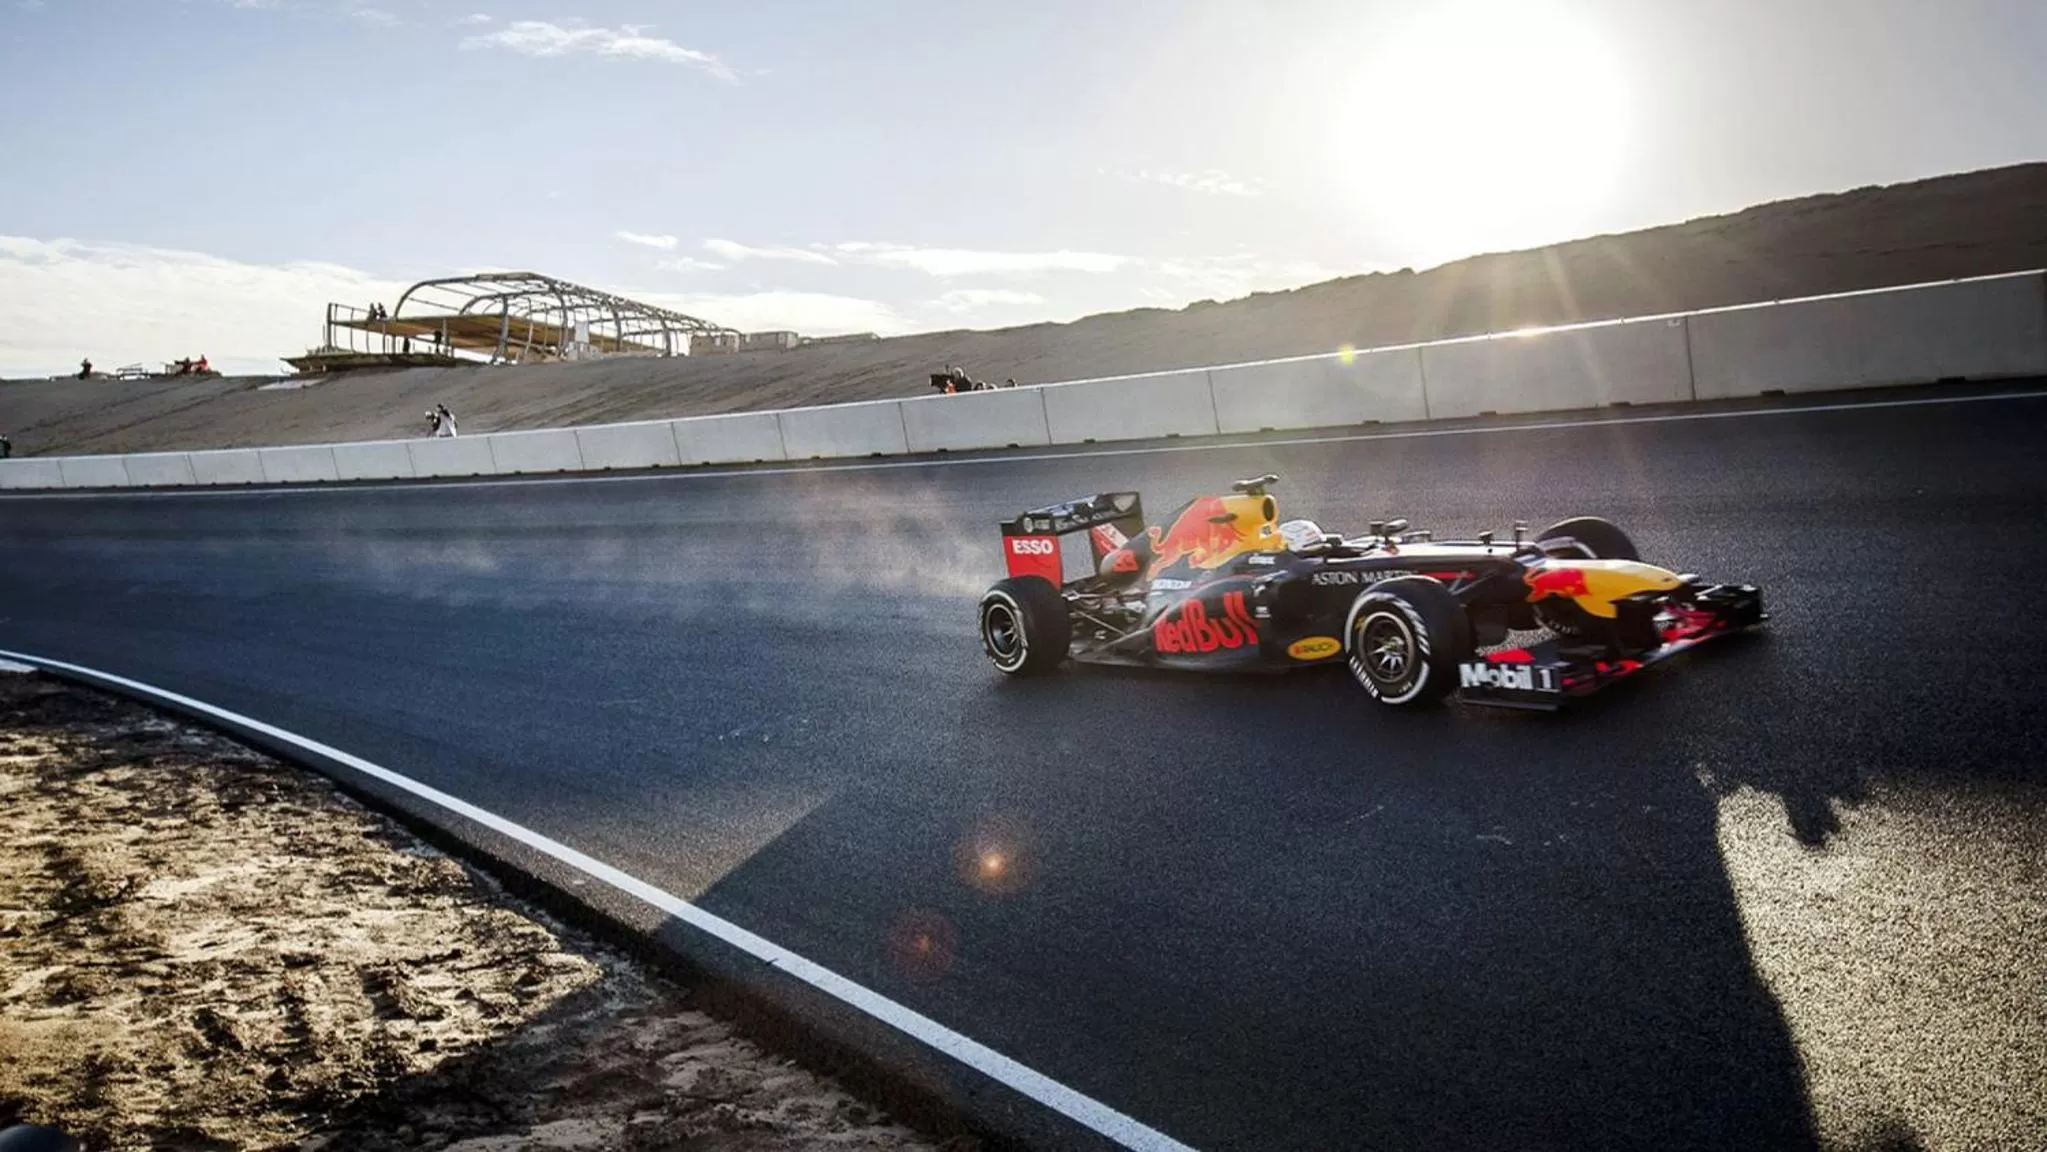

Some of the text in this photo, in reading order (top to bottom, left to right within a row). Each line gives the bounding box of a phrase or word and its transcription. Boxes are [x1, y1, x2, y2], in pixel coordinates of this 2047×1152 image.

[1012, 539, 1054, 555] ESSO
[1312, 571, 1358, 585] ASTON
[1459, 663, 1551, 690] Mobil 1
